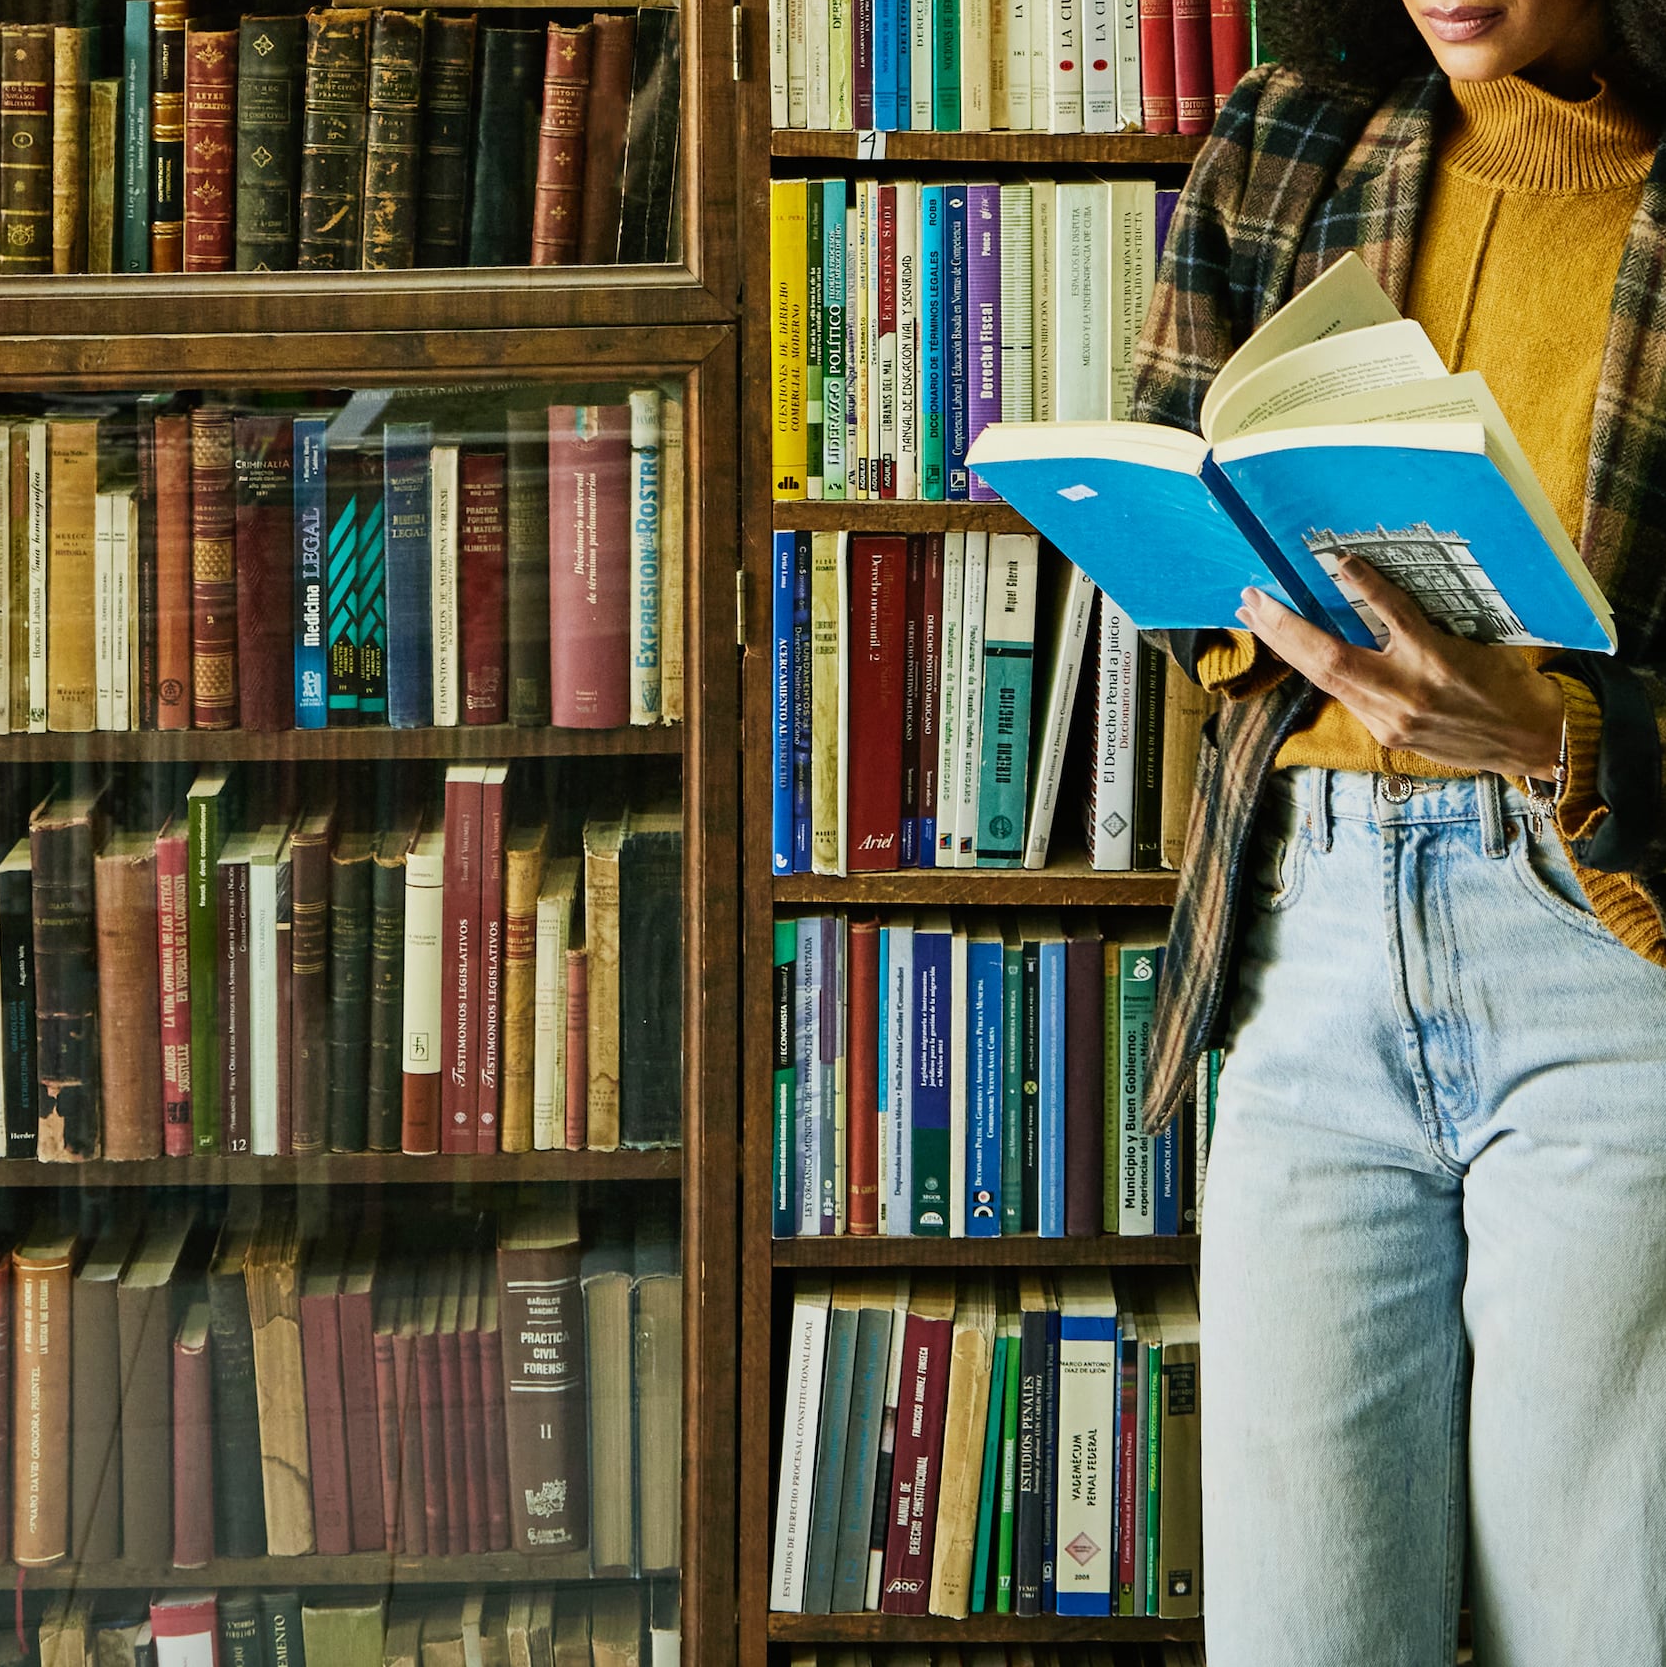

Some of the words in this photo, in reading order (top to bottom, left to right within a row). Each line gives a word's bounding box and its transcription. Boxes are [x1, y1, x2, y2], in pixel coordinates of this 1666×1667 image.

[1061, 29, 1072, 47] LA
[861, 132, 875, 159] 4
[929, 199, 937, 226] ROBB
[903, 256, 911, 307] SEGURIDAD
[930, 251, 938, 297] LEGALES
[826, 304, 840, 374] POLÍTICO
[903, 320, 911, 341] VIAL
[929, 300, 938, 351] TÉRMINOS
[979, 303, 992, 341] Fiscal
[901, 343, 912, 396] EDUCACIÓN
[930, 356, 938, 369] DE
[980, 345, 993, 398] Derecho
[827, 380, 841, 465] LIDERAZGO
[903, 399, 912, 411] DE
[930, 372, 939, 438] DICCIONARIO
[902, 414, 912, 452] MANUAL
[302, 508, 319, 578] LEGAL
[1109, 616, 1121, 654] juicio
[1107, 670, 1117, 705] Penal
[1105, 709, 1116, 766] Derecho
[1104, 769, 1115, 783] El
[858, 834, 894, 849] Ariel
[1125, 1031, 1136, 1094] Gobierno:
[1126, 1097, 1136, 1131] Buen
[1128, 1134, 1138, 1143] y
[1125, 1146, 1136, 1209] Municipio
[521, 1333, 569, 1344] PRACTICA
[533, 1348, 558, 1360] CIVIL
[524, 1363, 567, 1374] FORENSE
[1069, 1435, 1083, 1501] VADEMÉCUM
[1087, 1429, 1098, 1470] FEDERAL
[1087, 1474, 1097, 1506] PENAL
